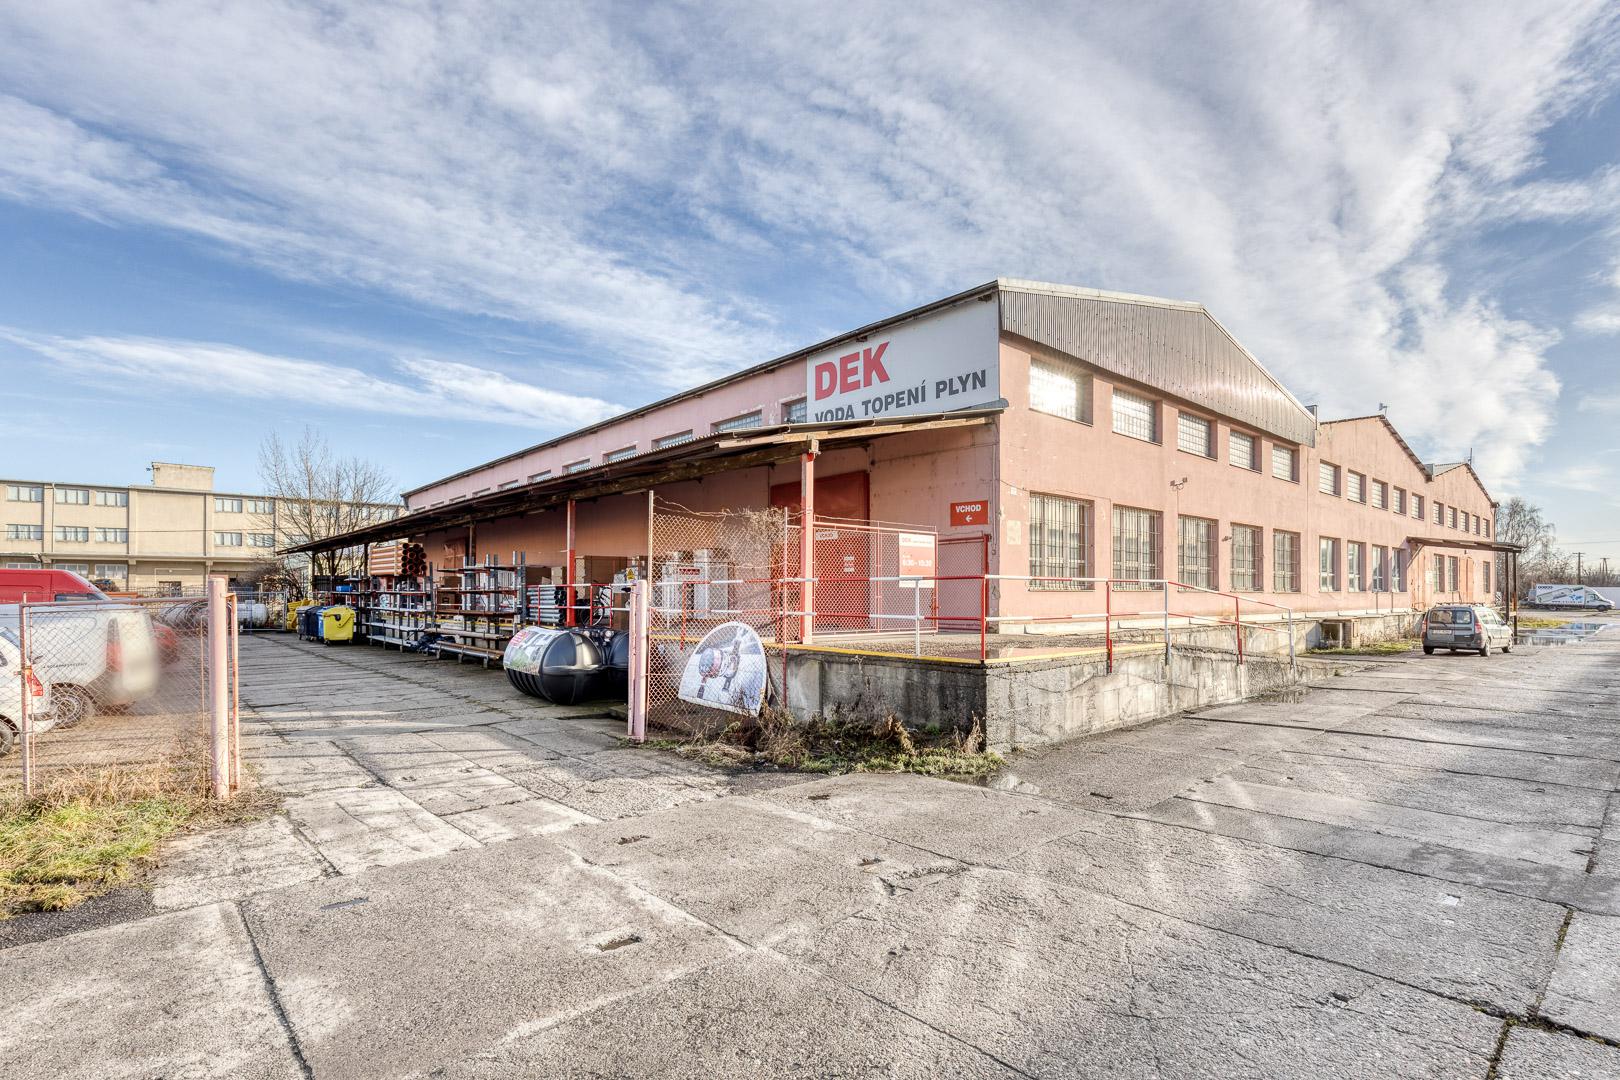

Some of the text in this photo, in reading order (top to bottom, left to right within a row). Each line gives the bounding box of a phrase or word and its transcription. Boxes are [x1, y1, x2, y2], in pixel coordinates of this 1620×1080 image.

[815, 341, 890, 401] DEK
[815, 369, 986, 422] VODA TOPENÍ PLYN
[956, 504, 982, 513] VCHOD
